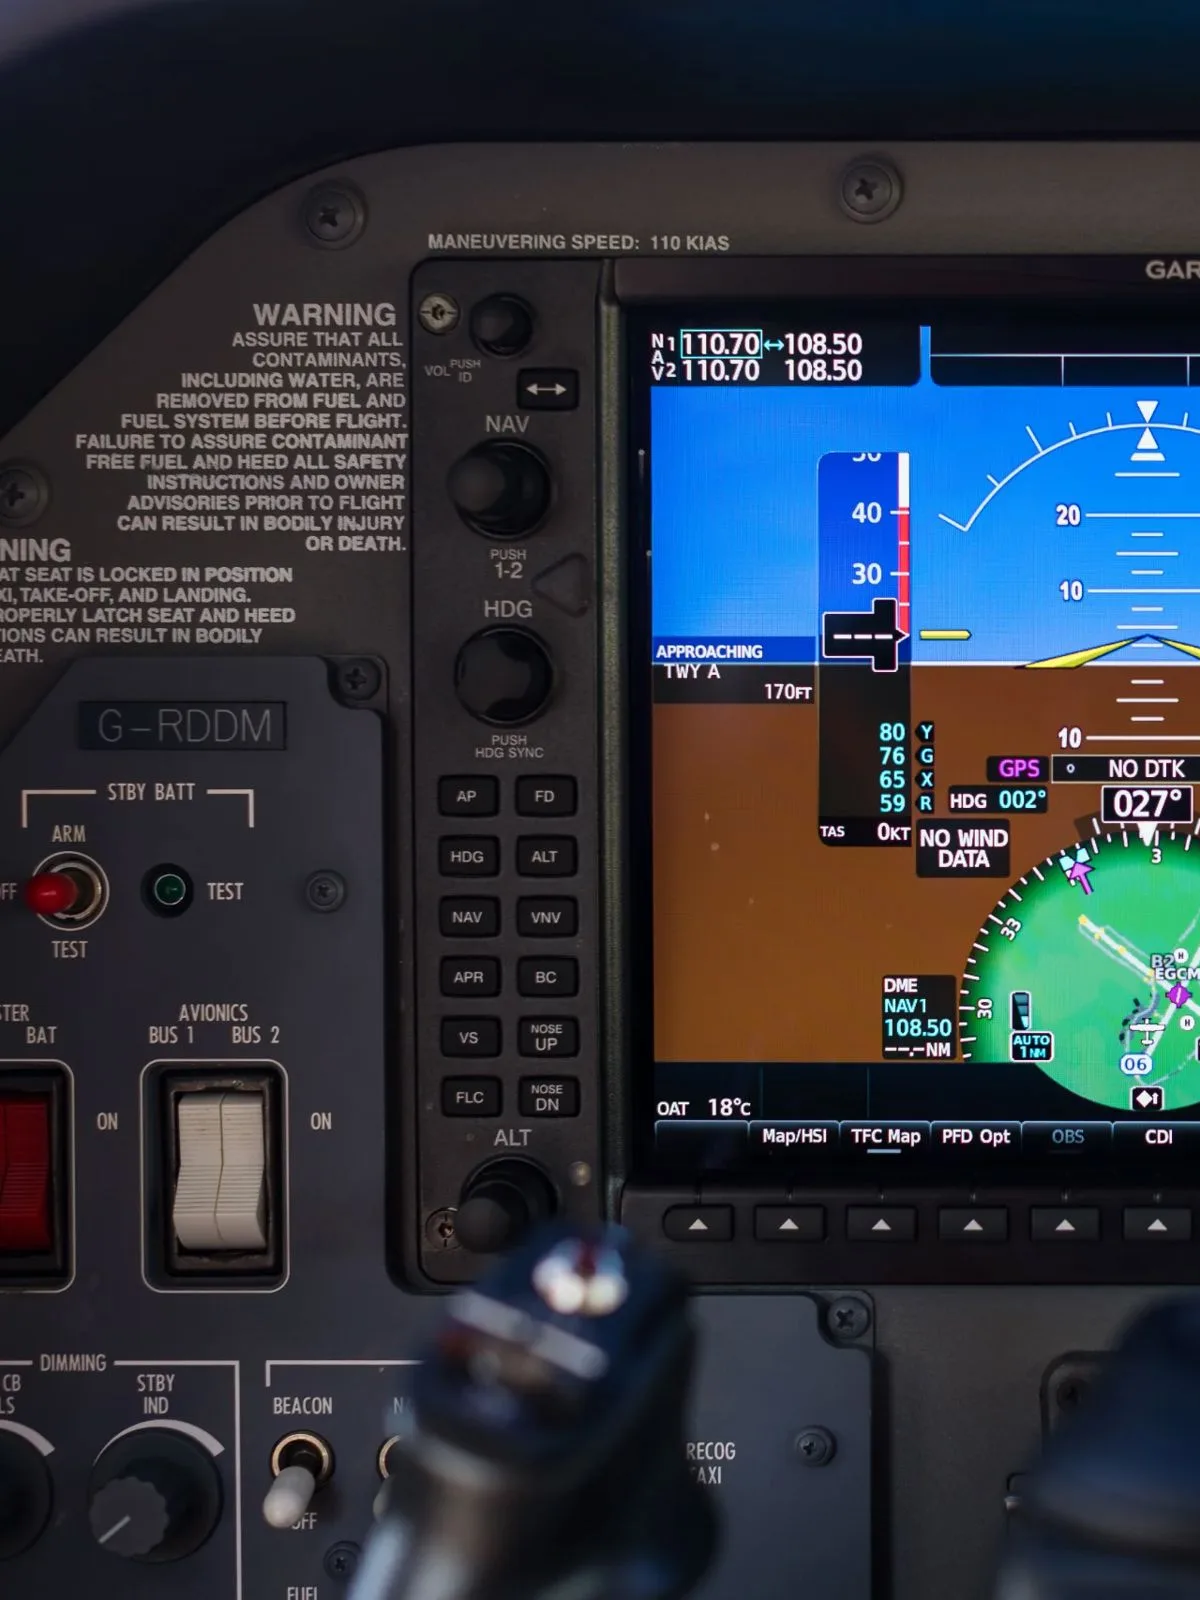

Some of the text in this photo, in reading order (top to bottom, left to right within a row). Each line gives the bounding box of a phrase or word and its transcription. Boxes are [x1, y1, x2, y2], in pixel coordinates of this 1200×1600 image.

[429, 234, 729, 251] MANEUVERING SPEED: 110 KIAS
[253, 303, 395, 326] WARNING
[233, 332, 403, 347] ASSURE THAT ALL
[682, 333, 760, 356] 110.70
[784, 333, 862, 356] 108.50
[253, 352, 406, 368] CONTAMINANTS,
[682, 360, 760, 382] 110.70
[784, 360, 862, 382] 108.50
[182, 372, 404, 390] INCLUDING WATER, ARE
[157, 393, 405, 408] REMOVED FROM FUEL AND
[486, 416, 529, 432] NAV
[852, 502, 881, 523] 40
[853, 563, 881, 584] 30
[485, 600, 532, 618] HDG
[656, 645, 762, 658] APPROACHING
[665, 664, 721, 680] TWY A
[880, 723, 905, 741] 80
[880, 747, 905, 765] 76
[999, 759, 1040, 777] GPS
[1110, 759, 1185, 777] NO DTK
[880, 770, 905, 788] 65
[108, 783, 195, 800] STBY BATT
[457, 791, 476, 802] AP
[536, 790, 554, 802] FD
[950, 790, 1047, 810] HDG 002°
[881, 794, 905, 812] 59
[1113, 788, 1183, 817] 027°
[52, 825, 85, 842] ARM
[920, 829, 1008, 847] NO WIND
[451, 851, 483, 863] HDG
[532, 851, 557, 862] ALT
[938, 850, 990, 869] DATA
[208, 883, 243, 900] TEST
[453, 912, 482, 923] NAV
[532, 912, 561, 923] VNV
[52, 941, 88, 958] TEST
[454, 972, 483, 983] APR
[536, 971, 556, 983] BC
[884, 978, 917, 992] DME
[179, 1004, 248, 1021] AVIONICS
[884, 998, 928, 1014] NAV1
[27, 1026, 56, 1043] BAT
[150, 1026, 193, 1043] BUS 1
[232, 1026, 279, 1043] BUS 2
[884, 1018, 953, 1038] 108.50
[460, 1032, 478, 1044] VS
[456, 1092, 483, 1103] FLC
[494, 1129, 532, 1146] ALT
[763, 1128, 826, 1146] Map/HSI
[851, 1129, 920, 1146] TFC Map
[943, 1129, 1010, 1147] PFD Opt
[1051, 1129, 1085, 1145] OBS
[1146, 1129, 1172, 1144] CDI
[41, 1354, 106, 1371] DIMMING
[137, 1374, 175, 1391] STBY
[144, 1397, 168, 1414] IND
[274, 1397, 332, 1414] BEACON
